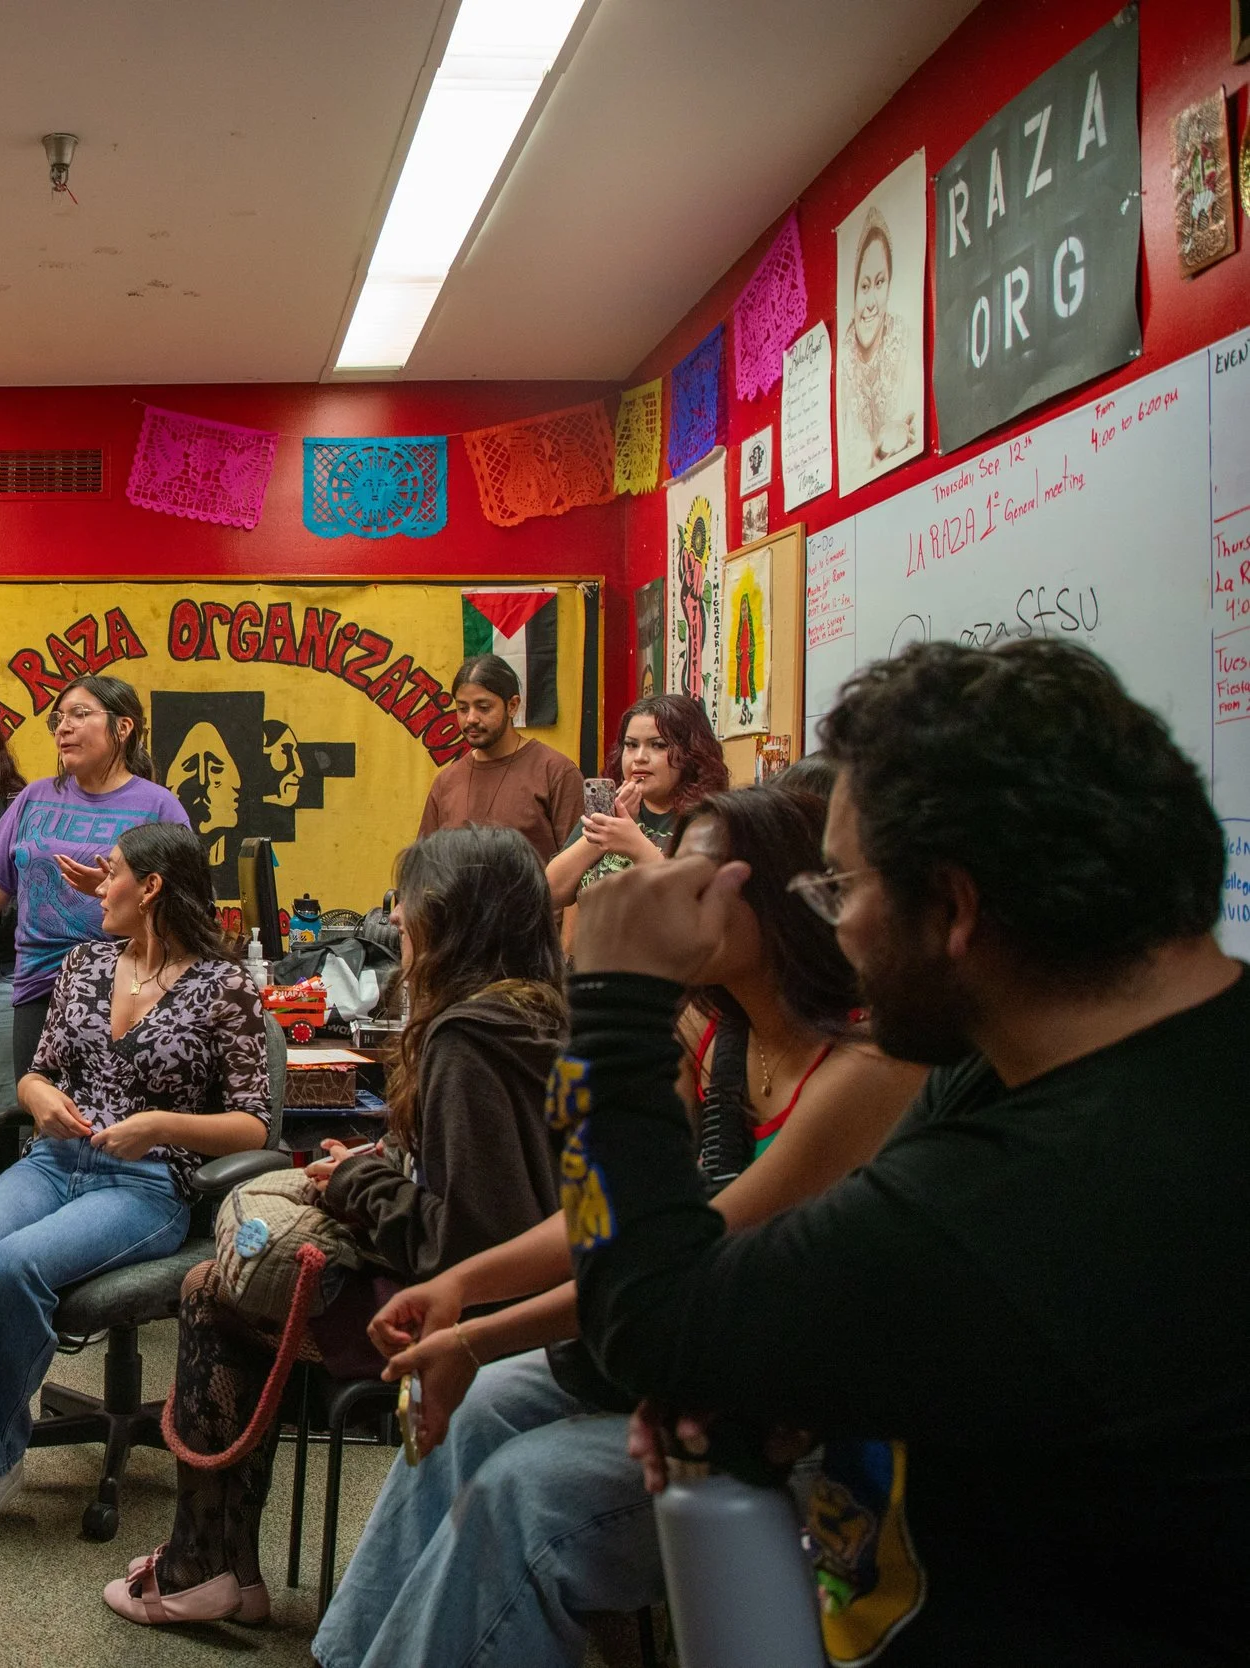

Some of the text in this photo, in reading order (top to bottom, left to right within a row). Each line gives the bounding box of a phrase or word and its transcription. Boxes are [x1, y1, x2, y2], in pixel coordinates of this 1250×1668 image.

[949, 70, 1107, 257] RAZA
[971, 237, 1085, 368] ORG
[1009, 436, 1033, 467] 12th
[1091, 428, 1116, 453] 4:00
[1121, 416, 1132, 431] to
[1138, 396, 1161, 421] 6:00
[906, 533, 926, 577] LA
[929, 508, 975, 558] RAZA
[1004, 467, 1039, 526] General
[1044, 454, 1087, 502] meeting
[1215, 571, 1234, 593] La
[8, 607, 147, 717] RAZA
